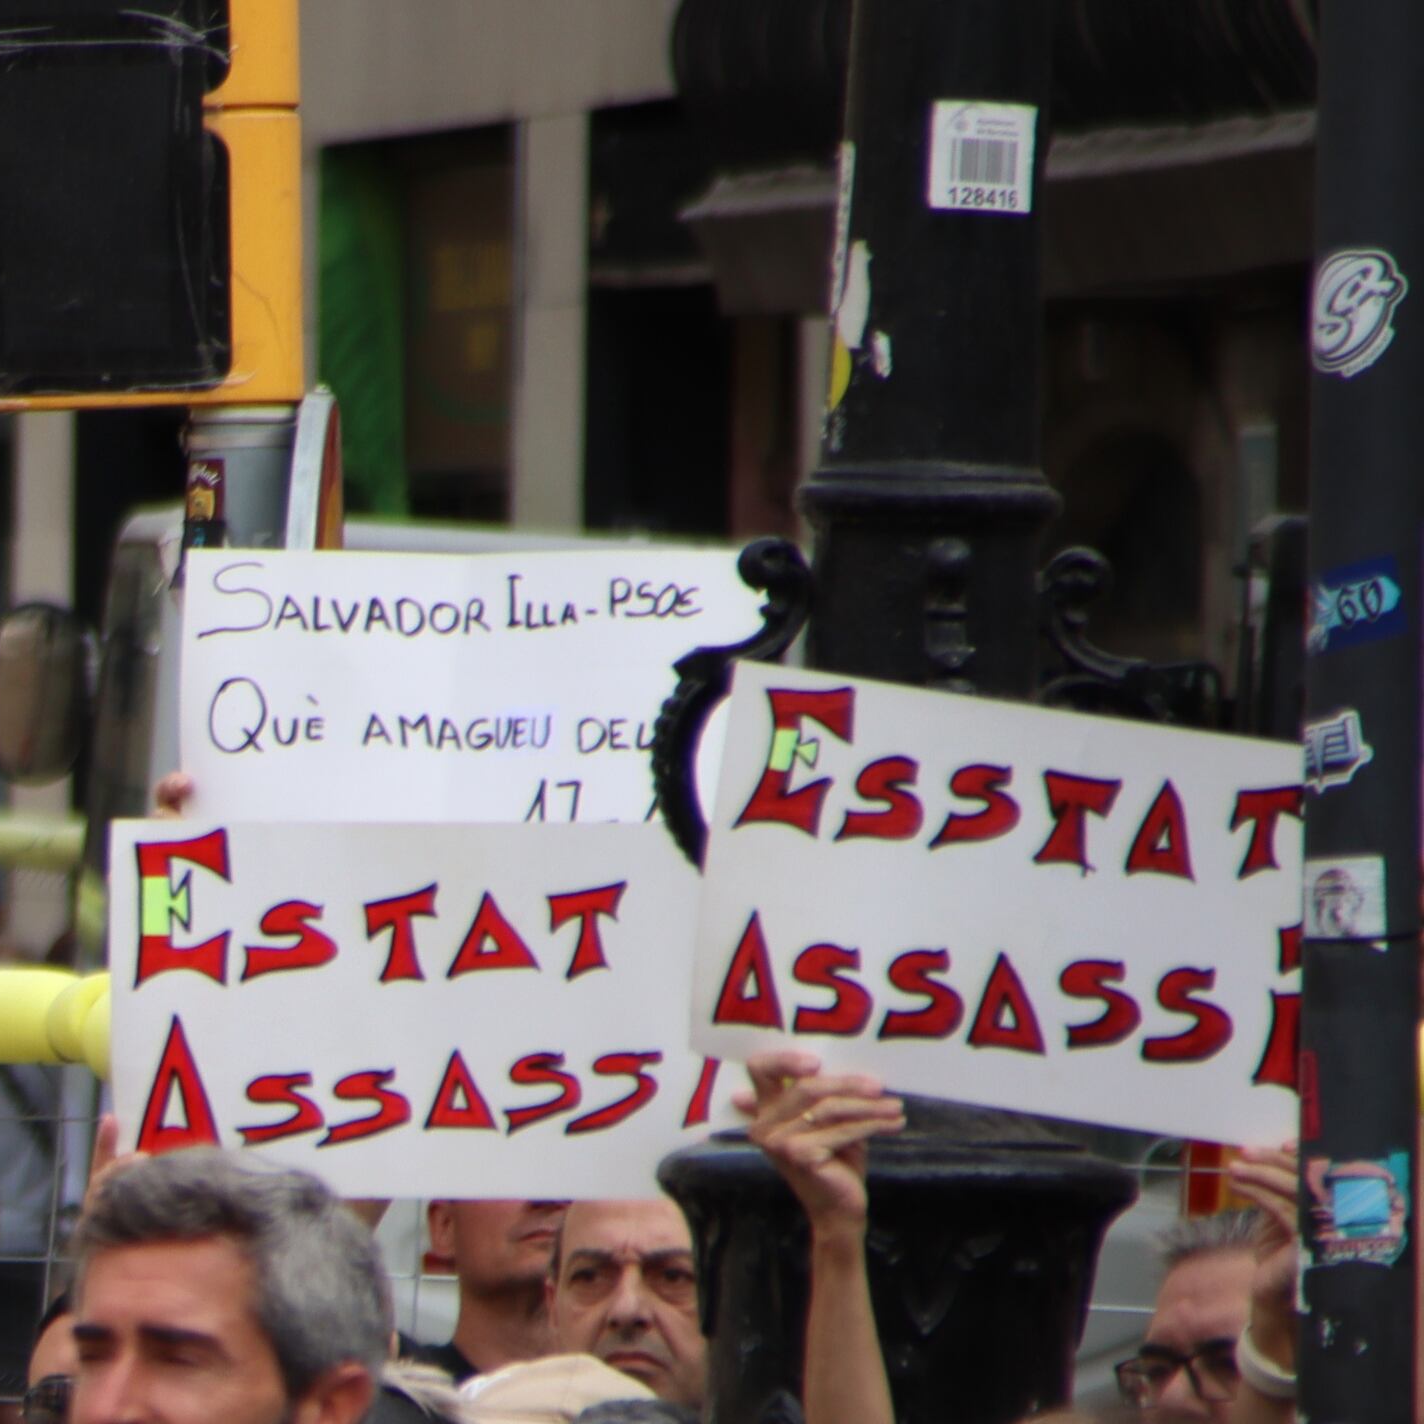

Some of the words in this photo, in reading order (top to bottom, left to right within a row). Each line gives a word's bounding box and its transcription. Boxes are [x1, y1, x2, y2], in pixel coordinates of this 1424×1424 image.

[948, 187, 1018, 209] 128416
[197, 561, 491, 639] SALVADOR
[208, 676, 326, 754] QUÈ
[362, 709, 552, 751] AMAGUEU
[733, 686, 1303, 881] ESSTAT
[134, 826, 627, 989] ESTAT
